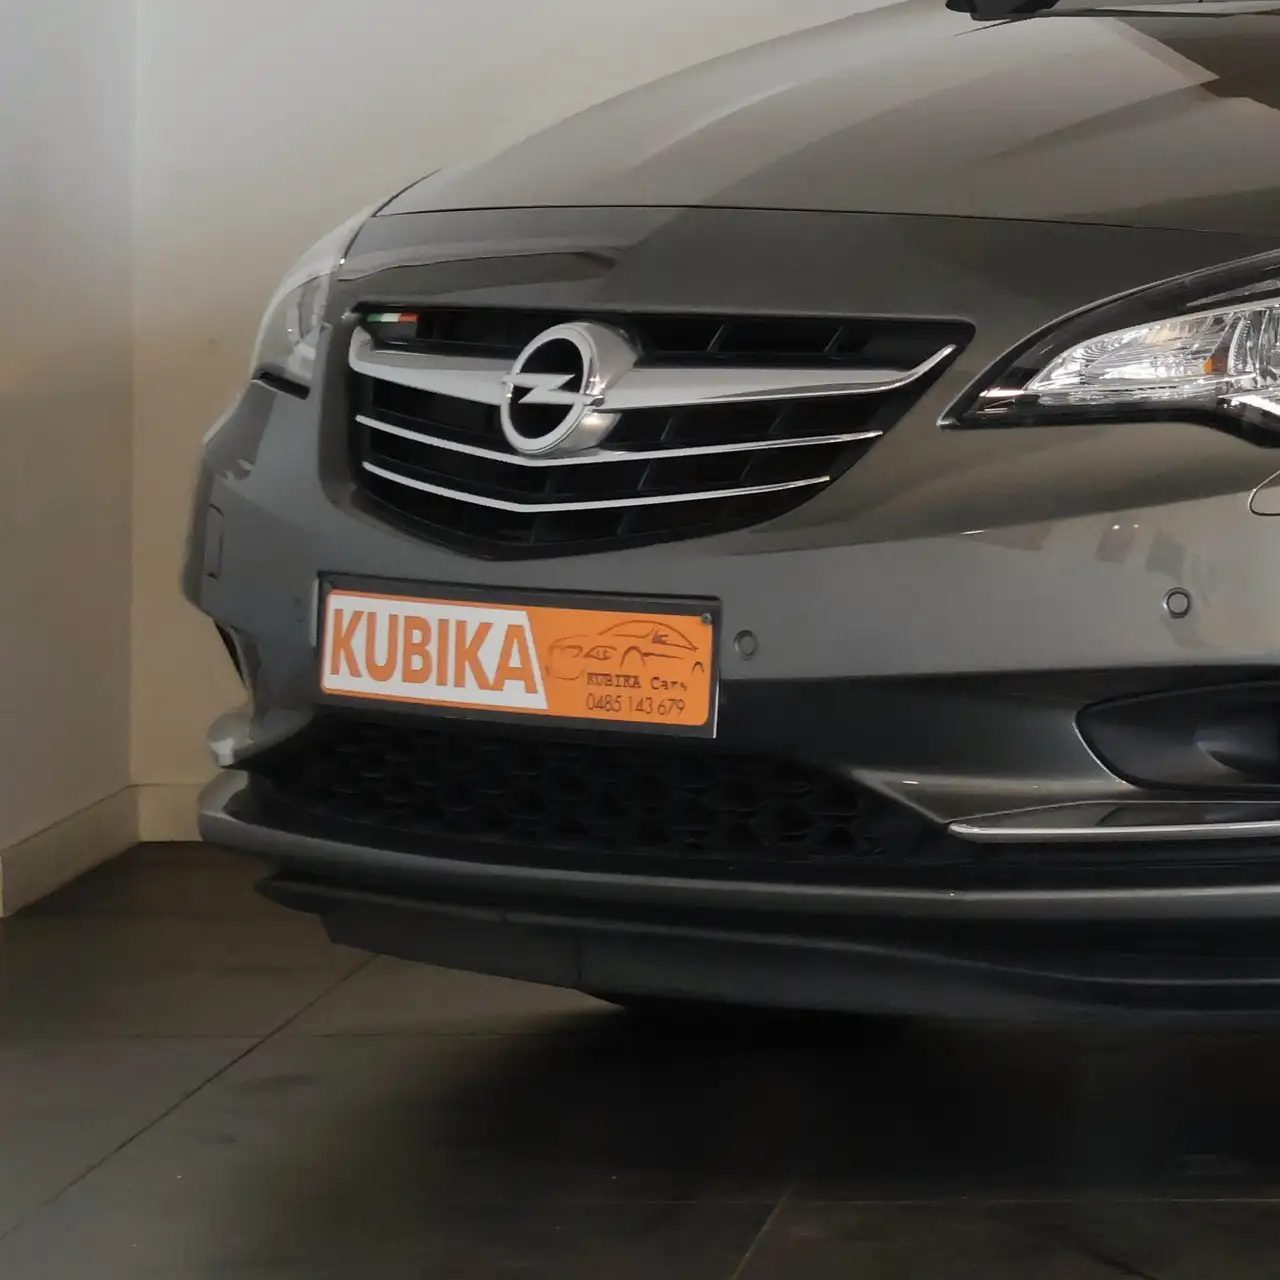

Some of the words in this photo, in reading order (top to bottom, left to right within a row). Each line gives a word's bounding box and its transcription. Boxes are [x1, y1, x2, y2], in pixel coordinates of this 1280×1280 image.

[330, 608, 539, 694] KUBIKA
[586, 672, 641, 689] KUBIKA
[650, 676, 688, 691] Cars
[585, 692, 622, 712] 0485
[628, 696, 653, 714] 143
[657, 698, 685, 717] 679
